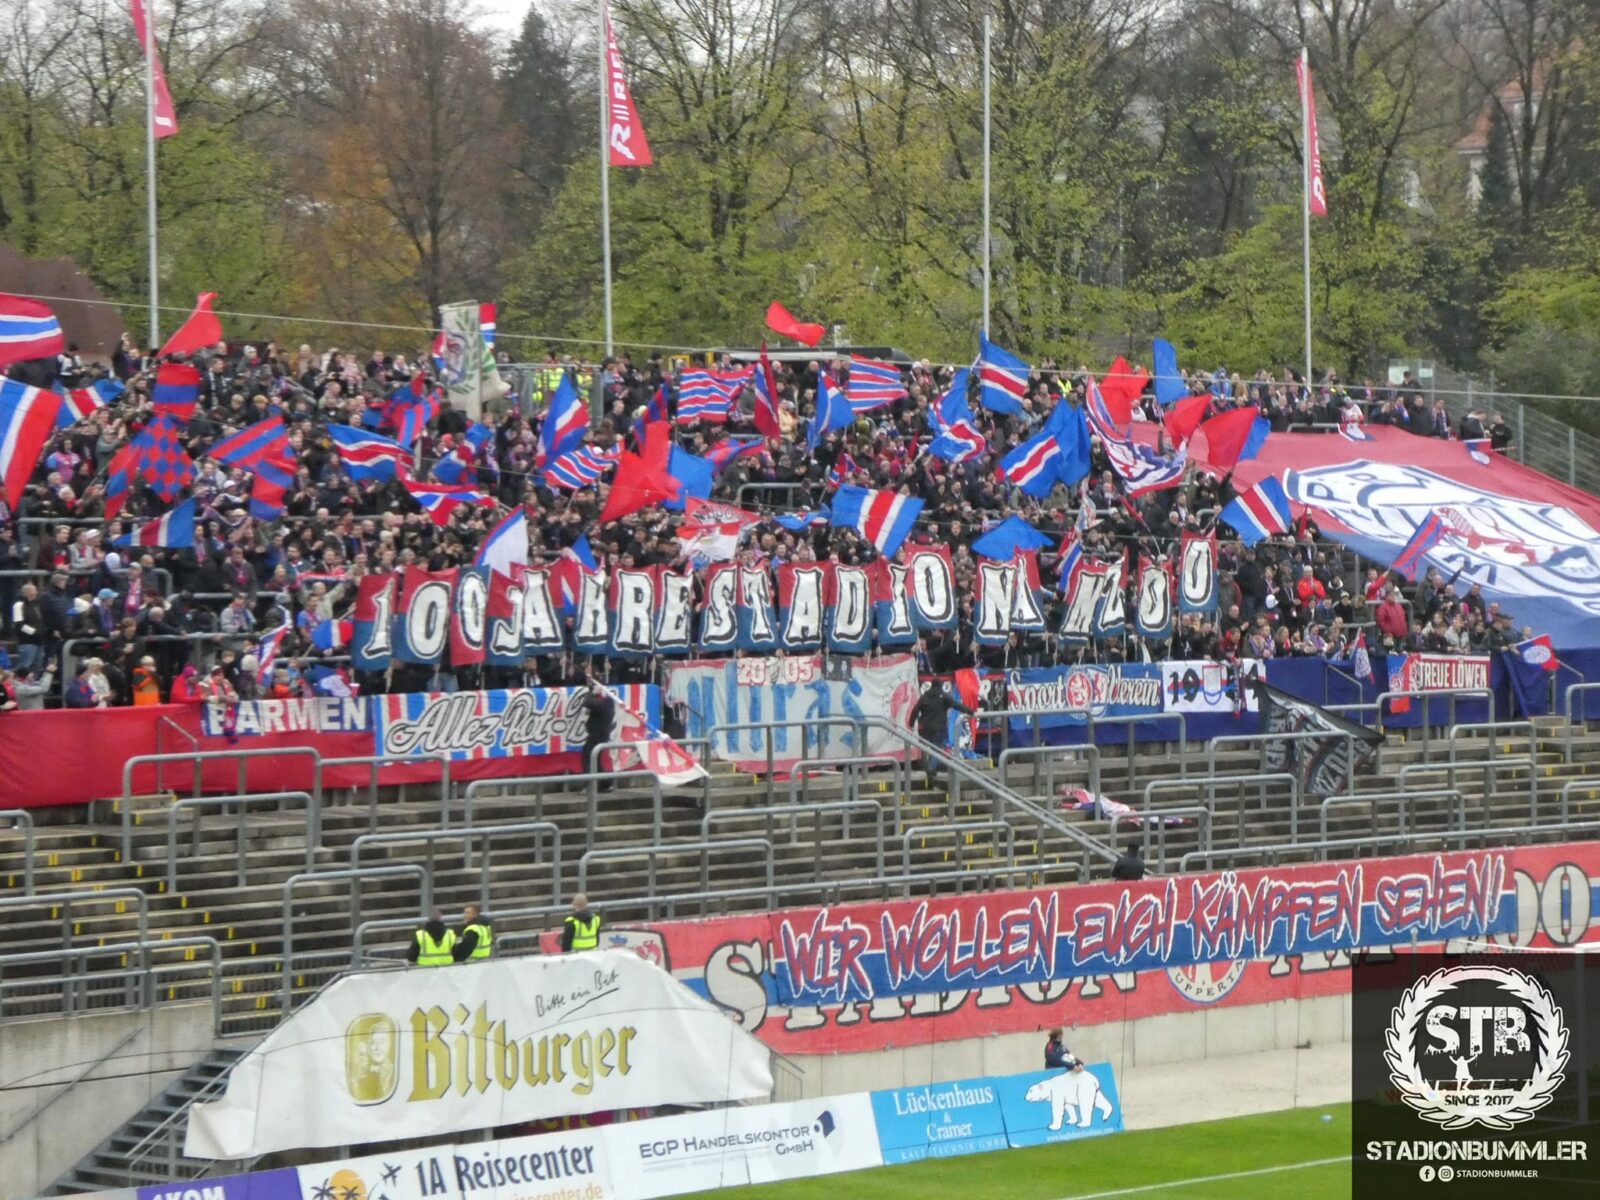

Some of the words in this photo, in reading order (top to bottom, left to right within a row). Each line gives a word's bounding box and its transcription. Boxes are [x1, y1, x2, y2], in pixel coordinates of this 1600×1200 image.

[361, 572, 488, 660] 100
[490, 566, 694, 656] JAHRE
[700, 551, 1017, 646] STADION
[1009, 553, 1109, 641] AM
[1007, 670, 1067, 724] Sport
[1100, 663, 1162, 707] Verein
[1169, 666, 1201, 707] 19
[1420, 661, 1450, 688] TREUE
[1452, 658, 1487, 688] LÖWEN
[386, 692, 502, 754] Allez
[781, 908, 874, 1001] WIR
[880, 891, 1059, 990] WOLLEN
[1068, 878, 1178, 967] EUCH
[1185, 863, 1363, 959] KÄMPFEN
[1374, 853, 1504, 935] SEHEN!
[534, 992, 566, 1018] Bitte
[571, 985, 591, 1001] ein
[593, 969, 620, 991] Bit
[406, 1000, 638, 1103] Bitburger
[893, 1083, 994, 1116] Lückenhaus
[639, 1139, 679, 1158] EGP
[926, 1122, 973, 1142] Cramer
[415, 1157, 447, 1197] 1A
[453, 1144, 595, 1192] Reisecenter
